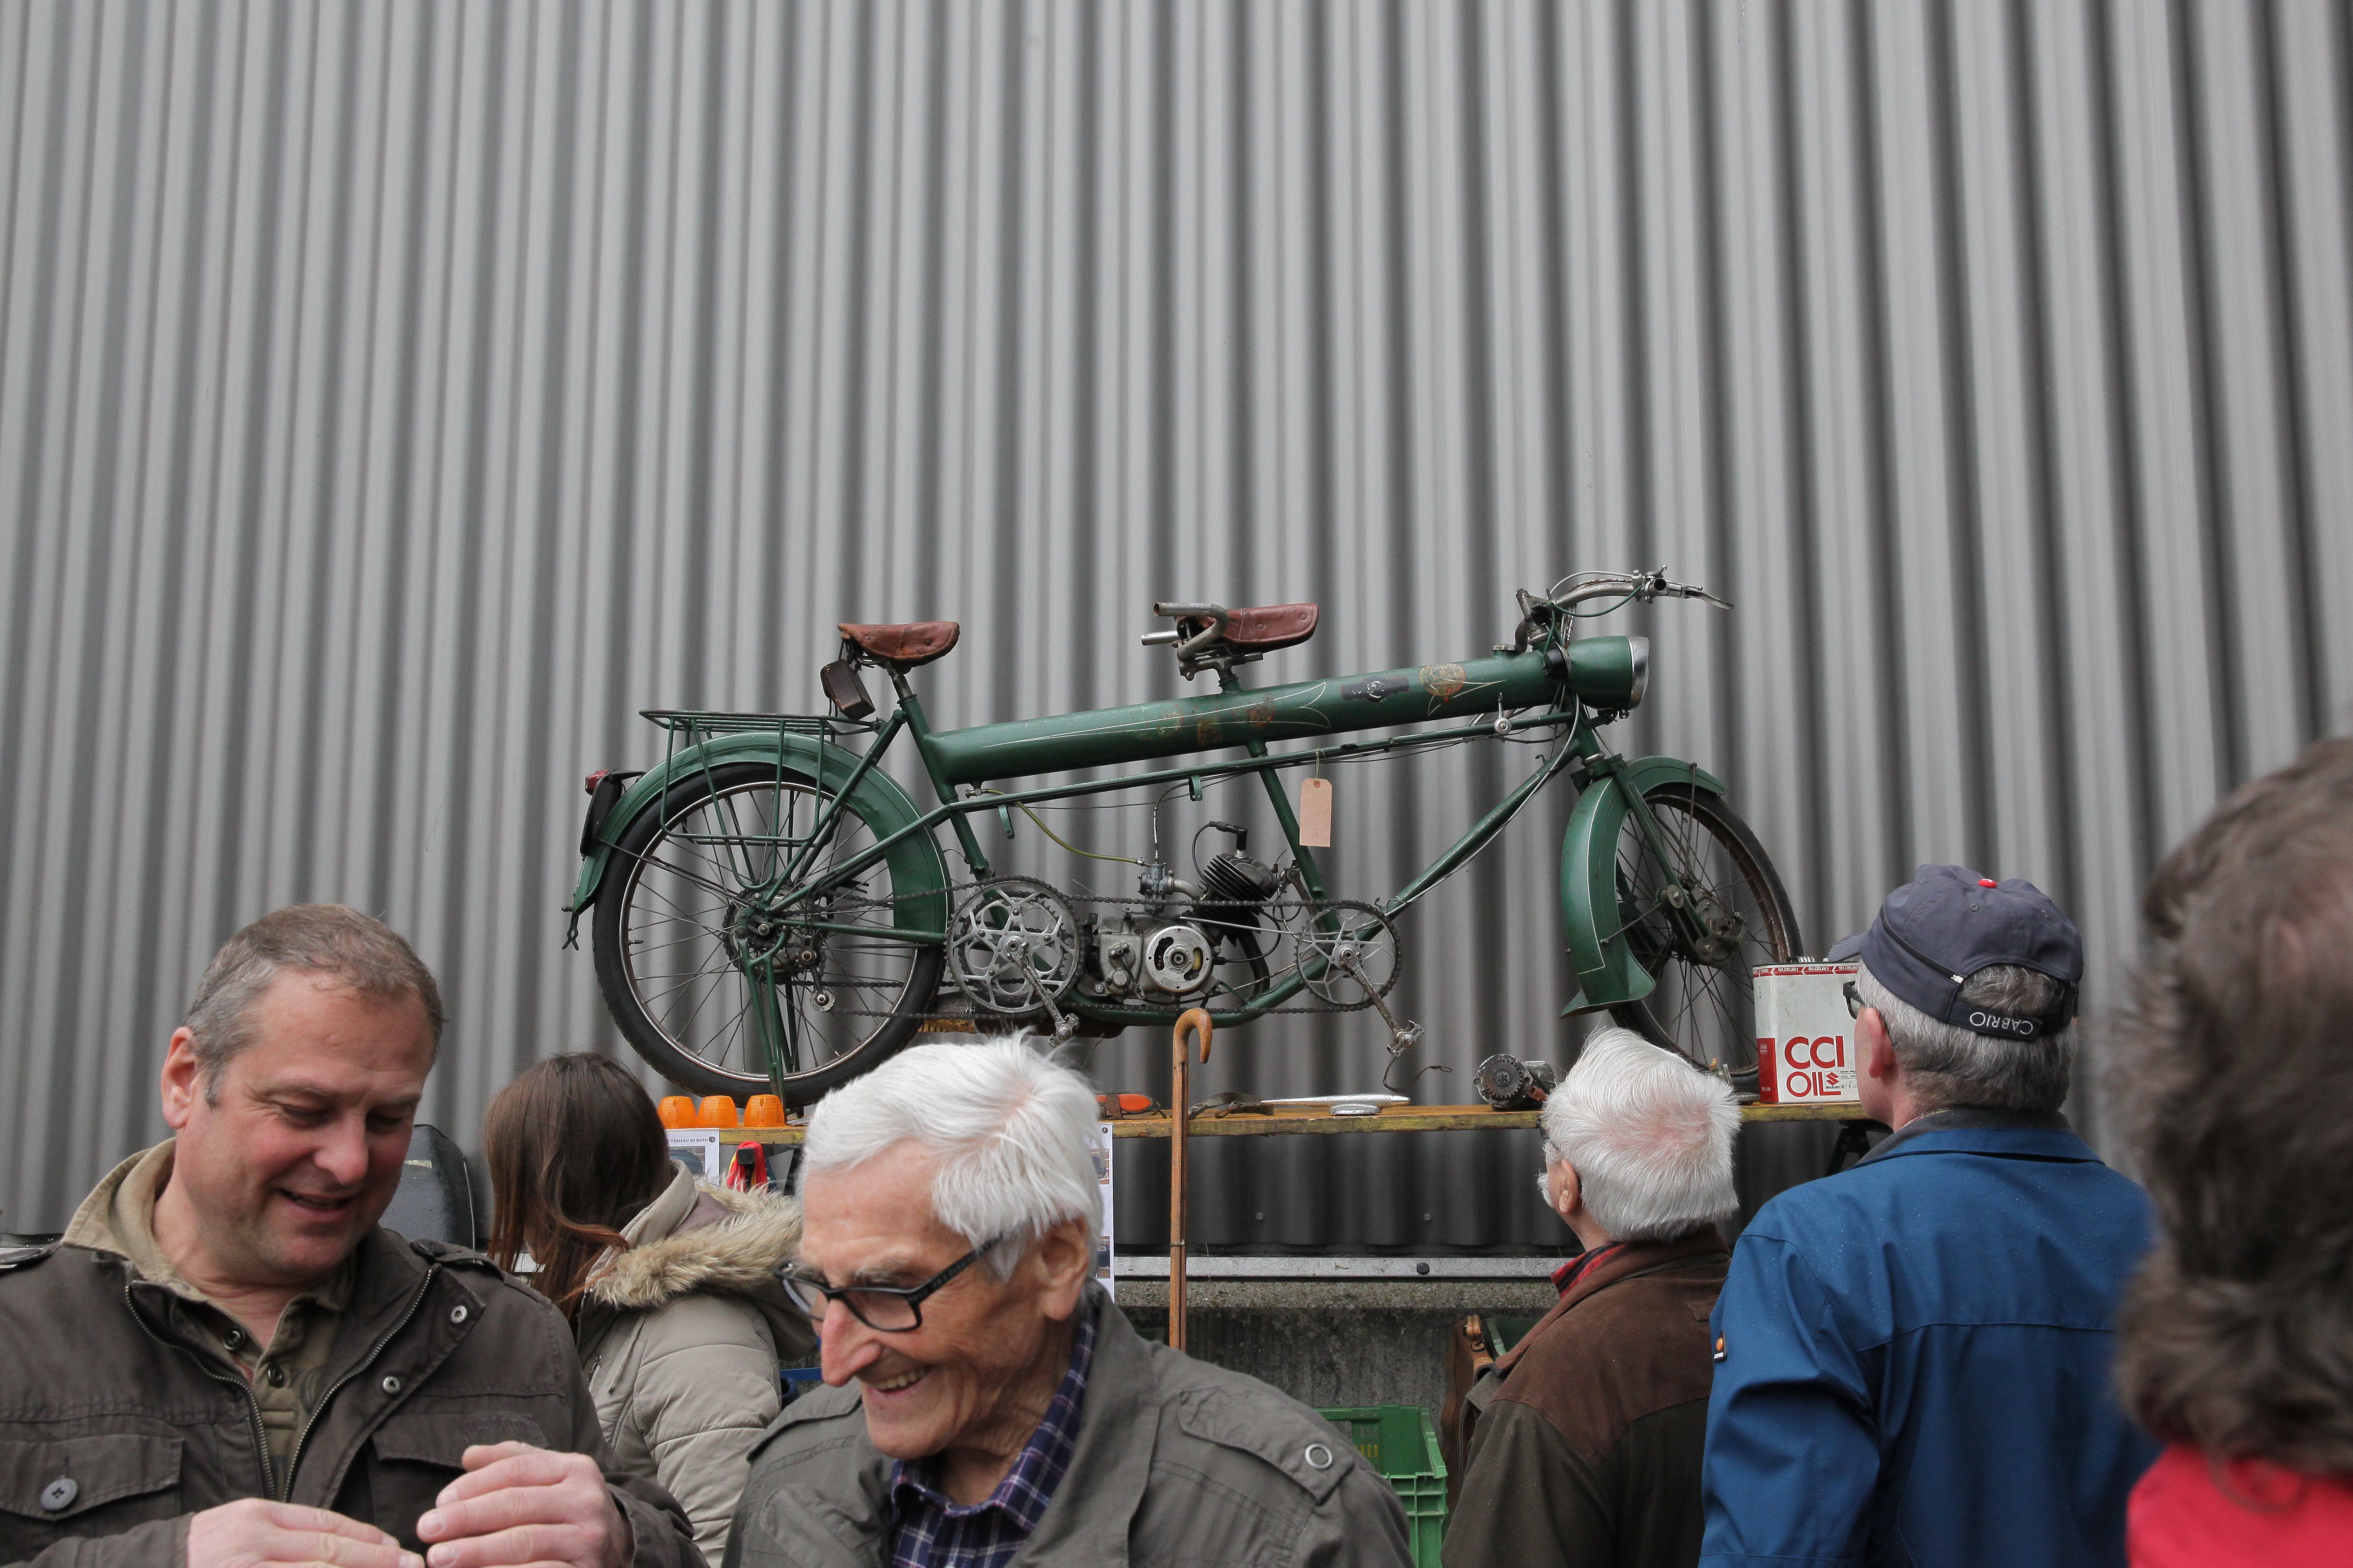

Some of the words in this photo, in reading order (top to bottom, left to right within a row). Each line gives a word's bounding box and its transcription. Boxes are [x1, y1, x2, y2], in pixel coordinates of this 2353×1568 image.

[1969, 1012, 2033, 1034] CABRIO
[1785, 1035, 1845, 1069] CCI
[1786, 1071, 1841, 1097] OIL
